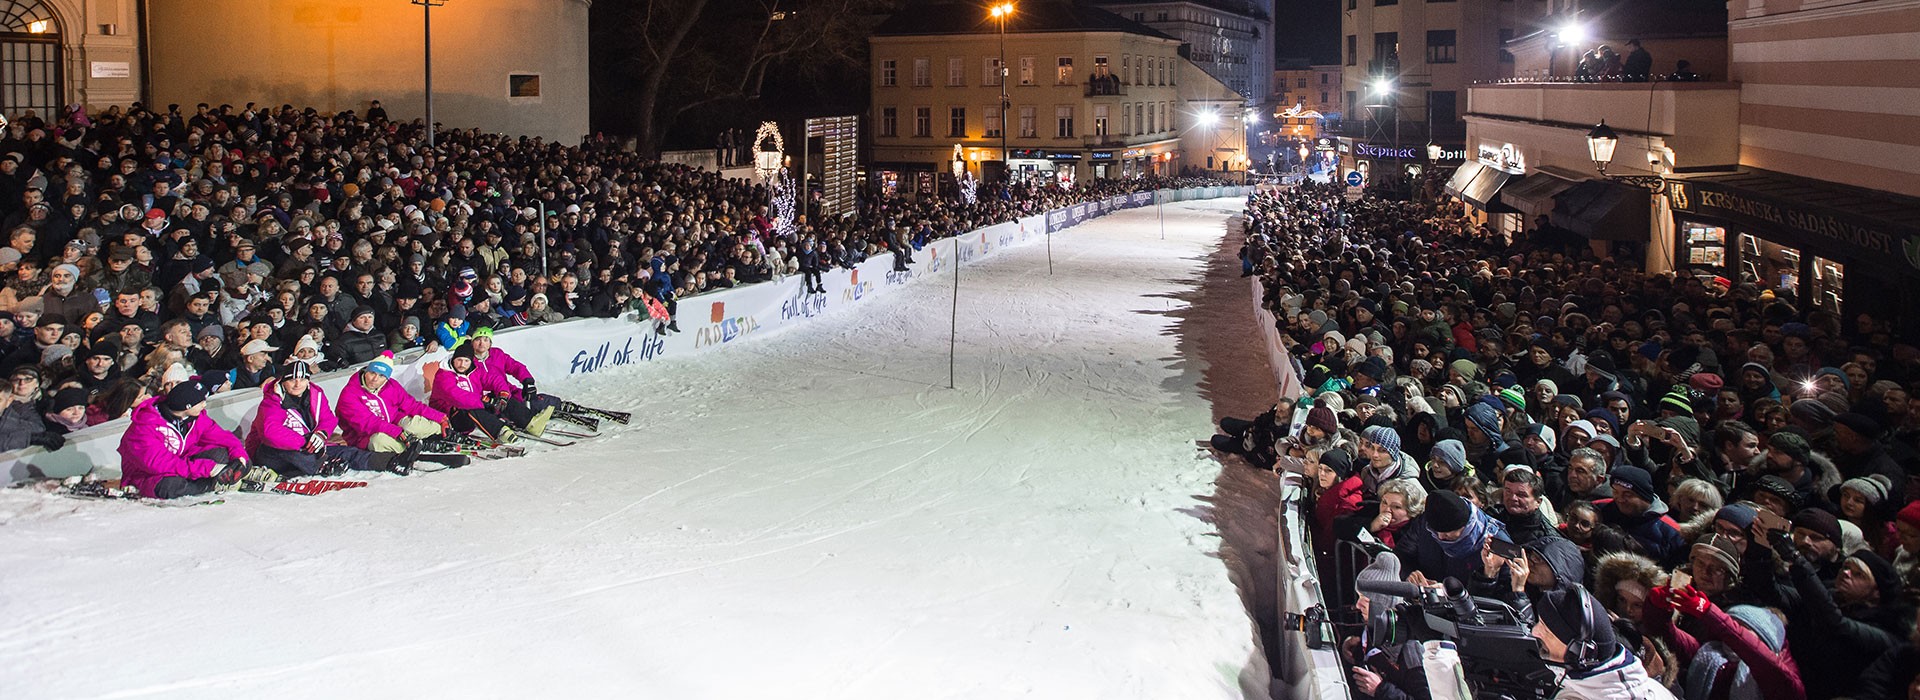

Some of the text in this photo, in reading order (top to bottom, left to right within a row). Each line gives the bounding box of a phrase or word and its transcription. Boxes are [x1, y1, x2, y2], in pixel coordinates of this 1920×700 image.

[1788, 210, 1892, 254] SADAŠNJOST
[570, 331, 665, 375] Full of life
[695, 316, 761, 349] CROATIA
